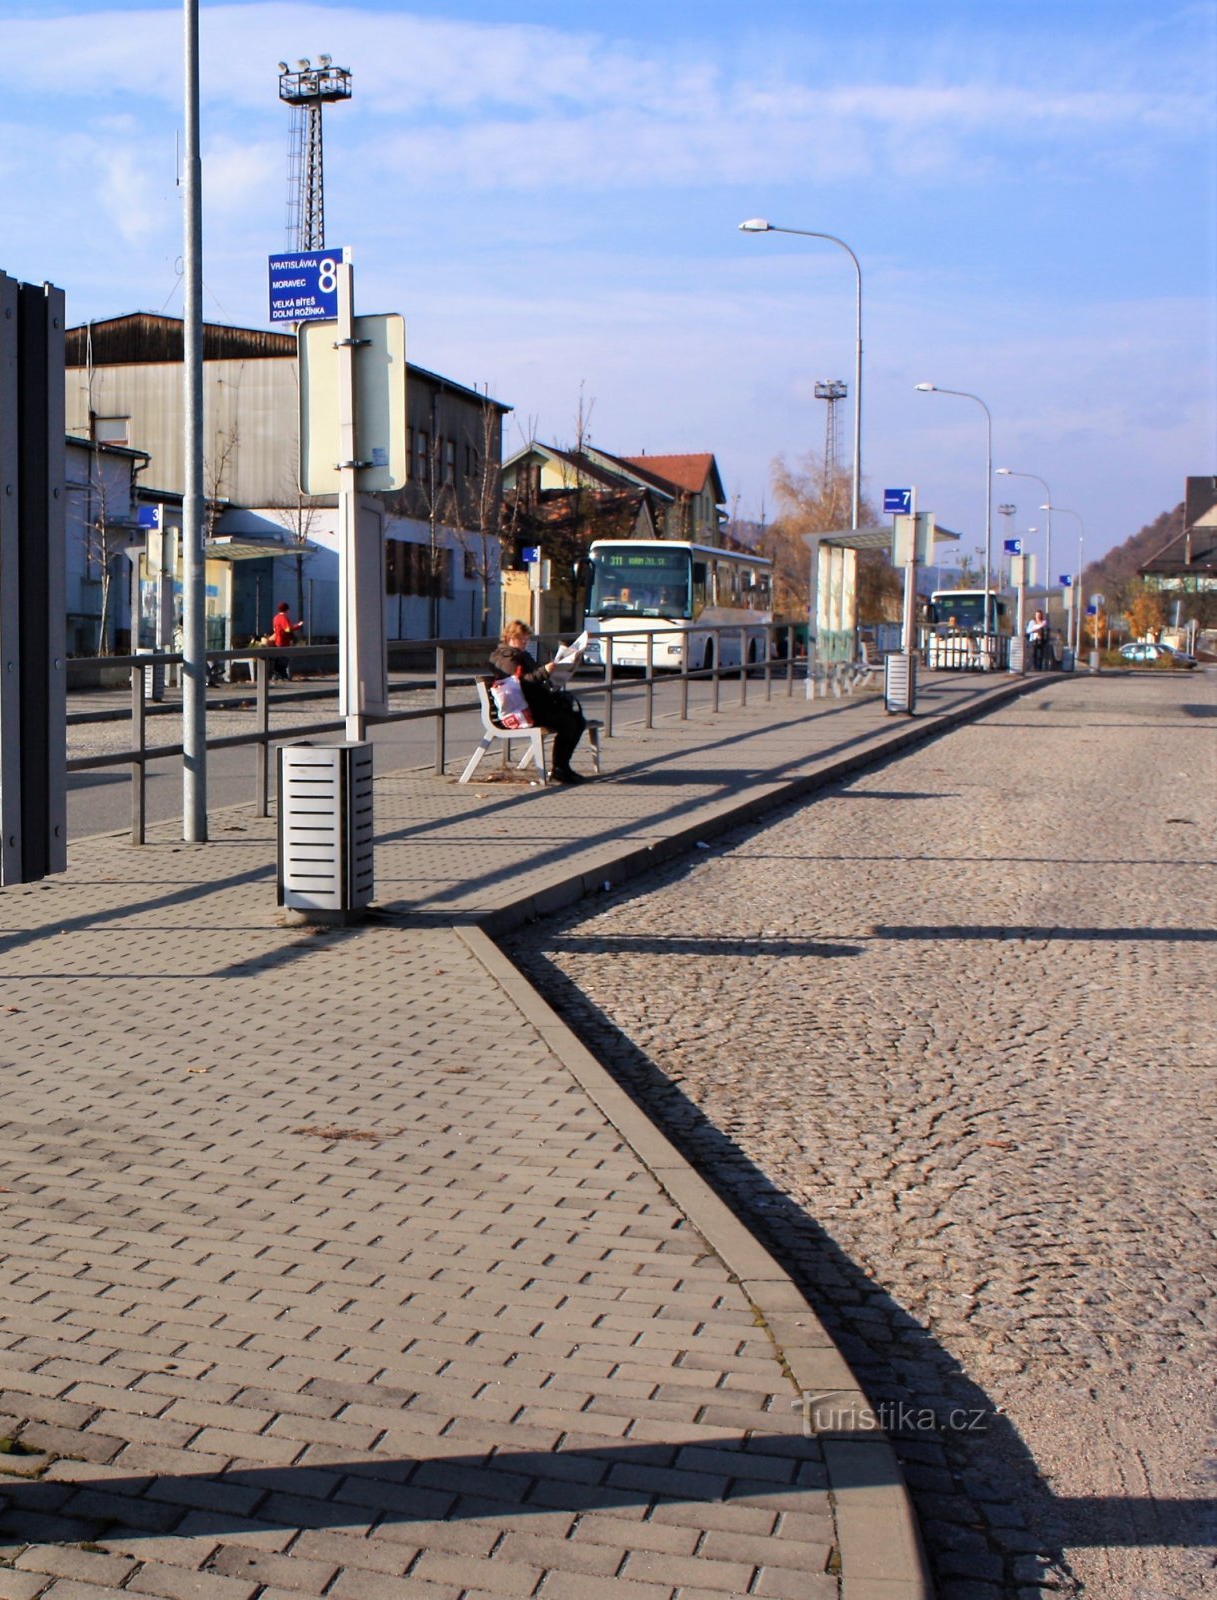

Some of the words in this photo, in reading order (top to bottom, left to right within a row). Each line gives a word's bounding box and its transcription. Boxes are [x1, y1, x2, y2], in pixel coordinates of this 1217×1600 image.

[271, 259, 317, 270] VRATISLÁVKA
[318, 258, 337, 294] 8
[272, 279, 306, 289] MORAVEC
[272, 298, 295, 308] VELKÁ
[296, 296, 316, 307] BÍTEŠ
[273, 308, 294, 318] DOLNÍ
[295, 307, 325, 317] ROŽÍNKA
[902, 491, 911, 506] 7
[152, 508, 159, 522] 3
[1014, 541, 1020, 551] 6
[532, 549, 538, 558] 2
